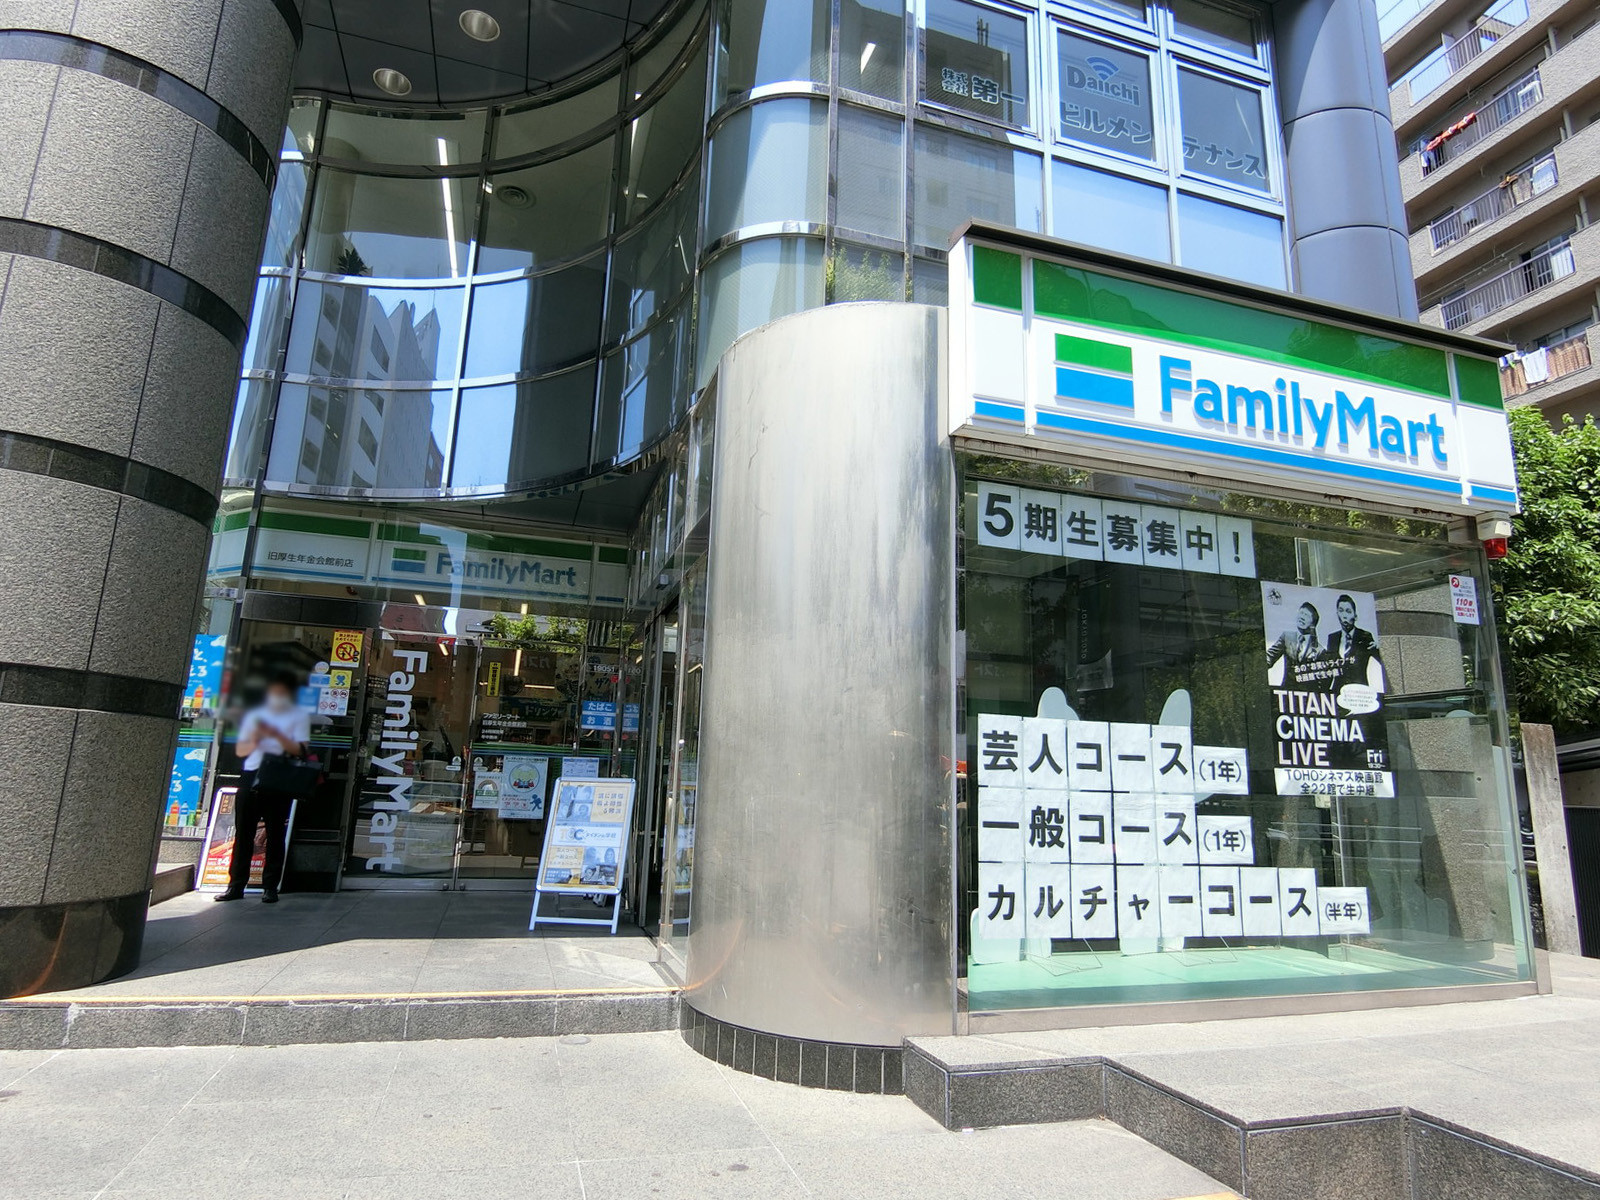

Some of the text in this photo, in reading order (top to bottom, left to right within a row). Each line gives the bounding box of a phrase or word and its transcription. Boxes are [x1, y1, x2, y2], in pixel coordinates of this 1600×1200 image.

[941, 80, 969, 97] 会社
[942, 67, 968, 86] 株式
[1066, 64, 1141, 107] Daiichi
[1158, 354, 1448, 465] FamilyMart
[267, 550, 355, 569] 旧厚生年金会館前店
[435, 552, 578, 589] FamilyMart
[588, 702, 613, 712] たばこ
[1273, 689, 1337, 717] TITAN
[1276, 714, 1365, 743] CINEMA
[365, 648, 429, 872] FamilyMart
[981, 729, 1189, 777] 芸人コース
[1278, 741, 1330, 767] LIVE
[1366, 749, 1384, 764] Fri
[1284, 768, 1385, 785] TOHOシネマズ映画館
[1300, 783, 1376, 797] 全22館で生中継
[981, 805, 1193, 850] 一般コース
[987, 883, 1313, 922] カルチャーコース
